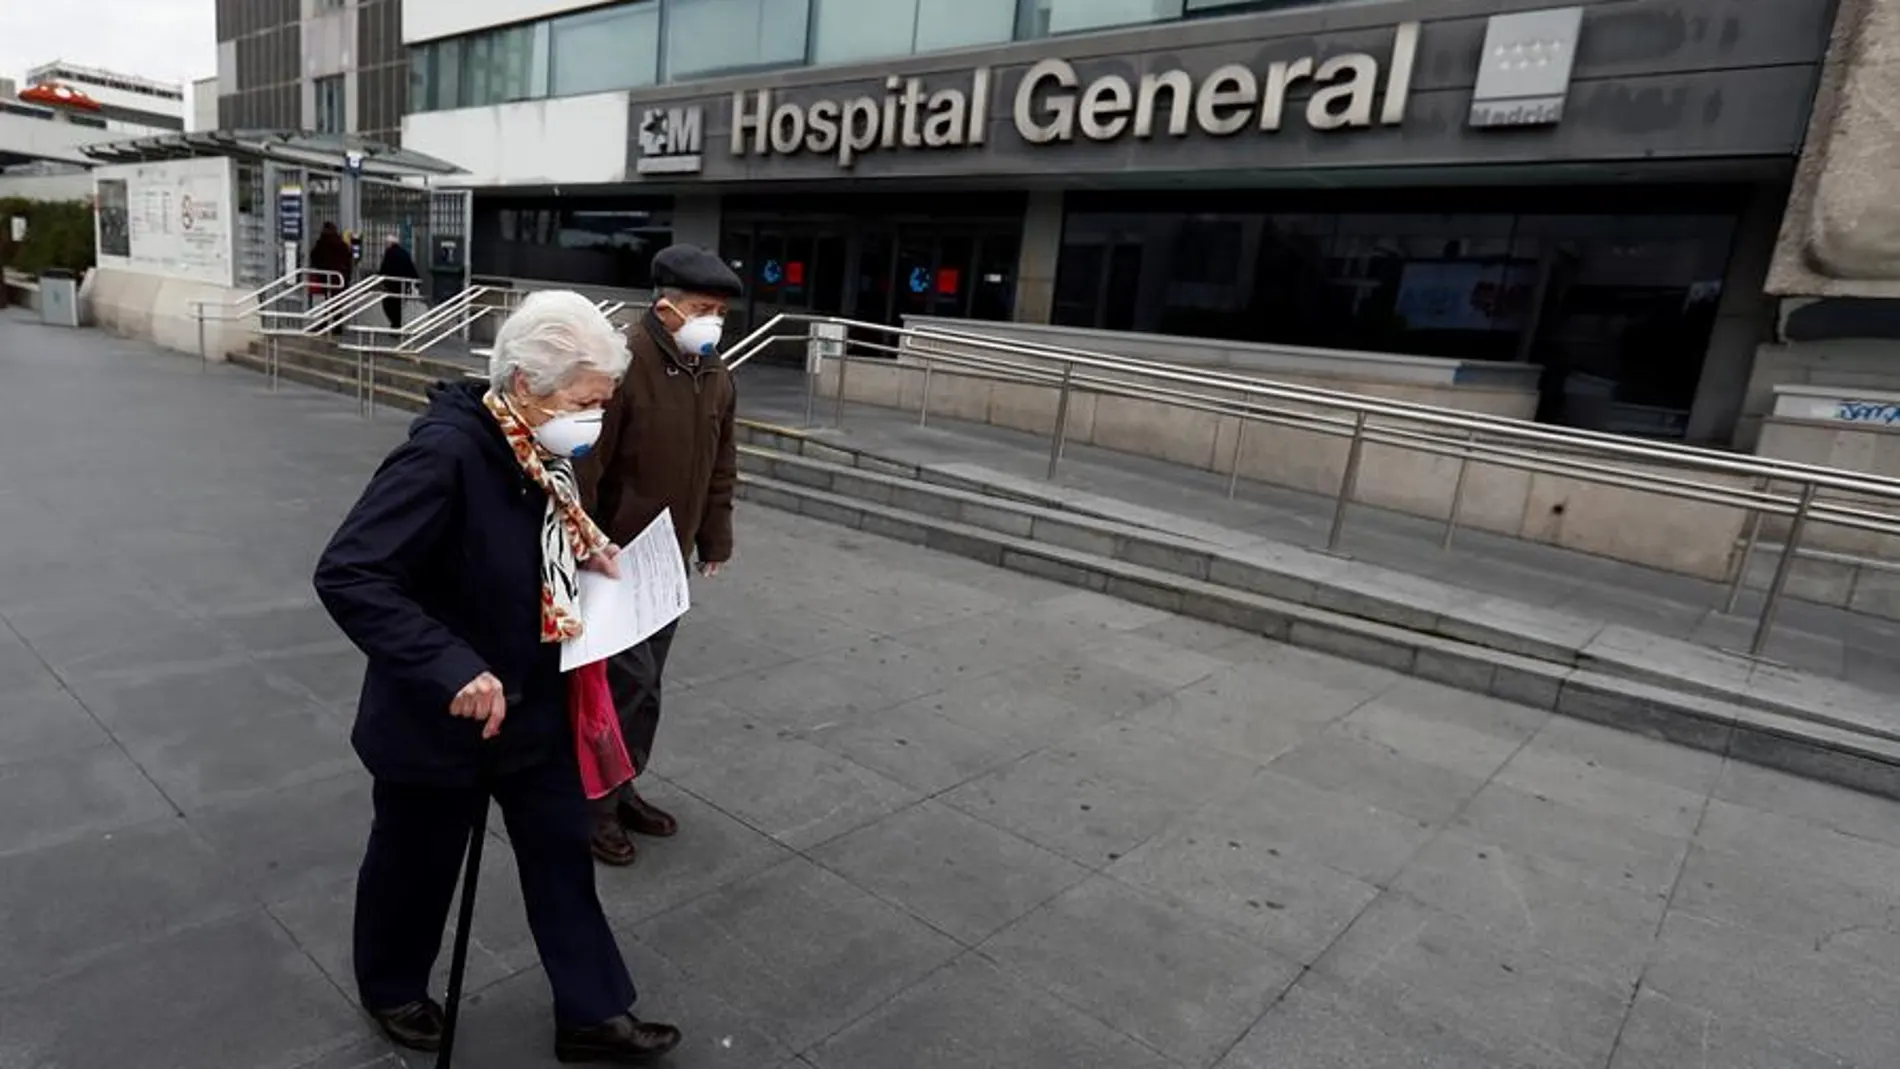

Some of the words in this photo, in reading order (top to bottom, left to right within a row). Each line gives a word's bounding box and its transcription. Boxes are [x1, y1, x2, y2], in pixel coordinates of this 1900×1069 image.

[731, 68, 988, 167] Hospital
[1014, 22, 1418, 143] General
[1469, 103, 1562, 126] Madrid
